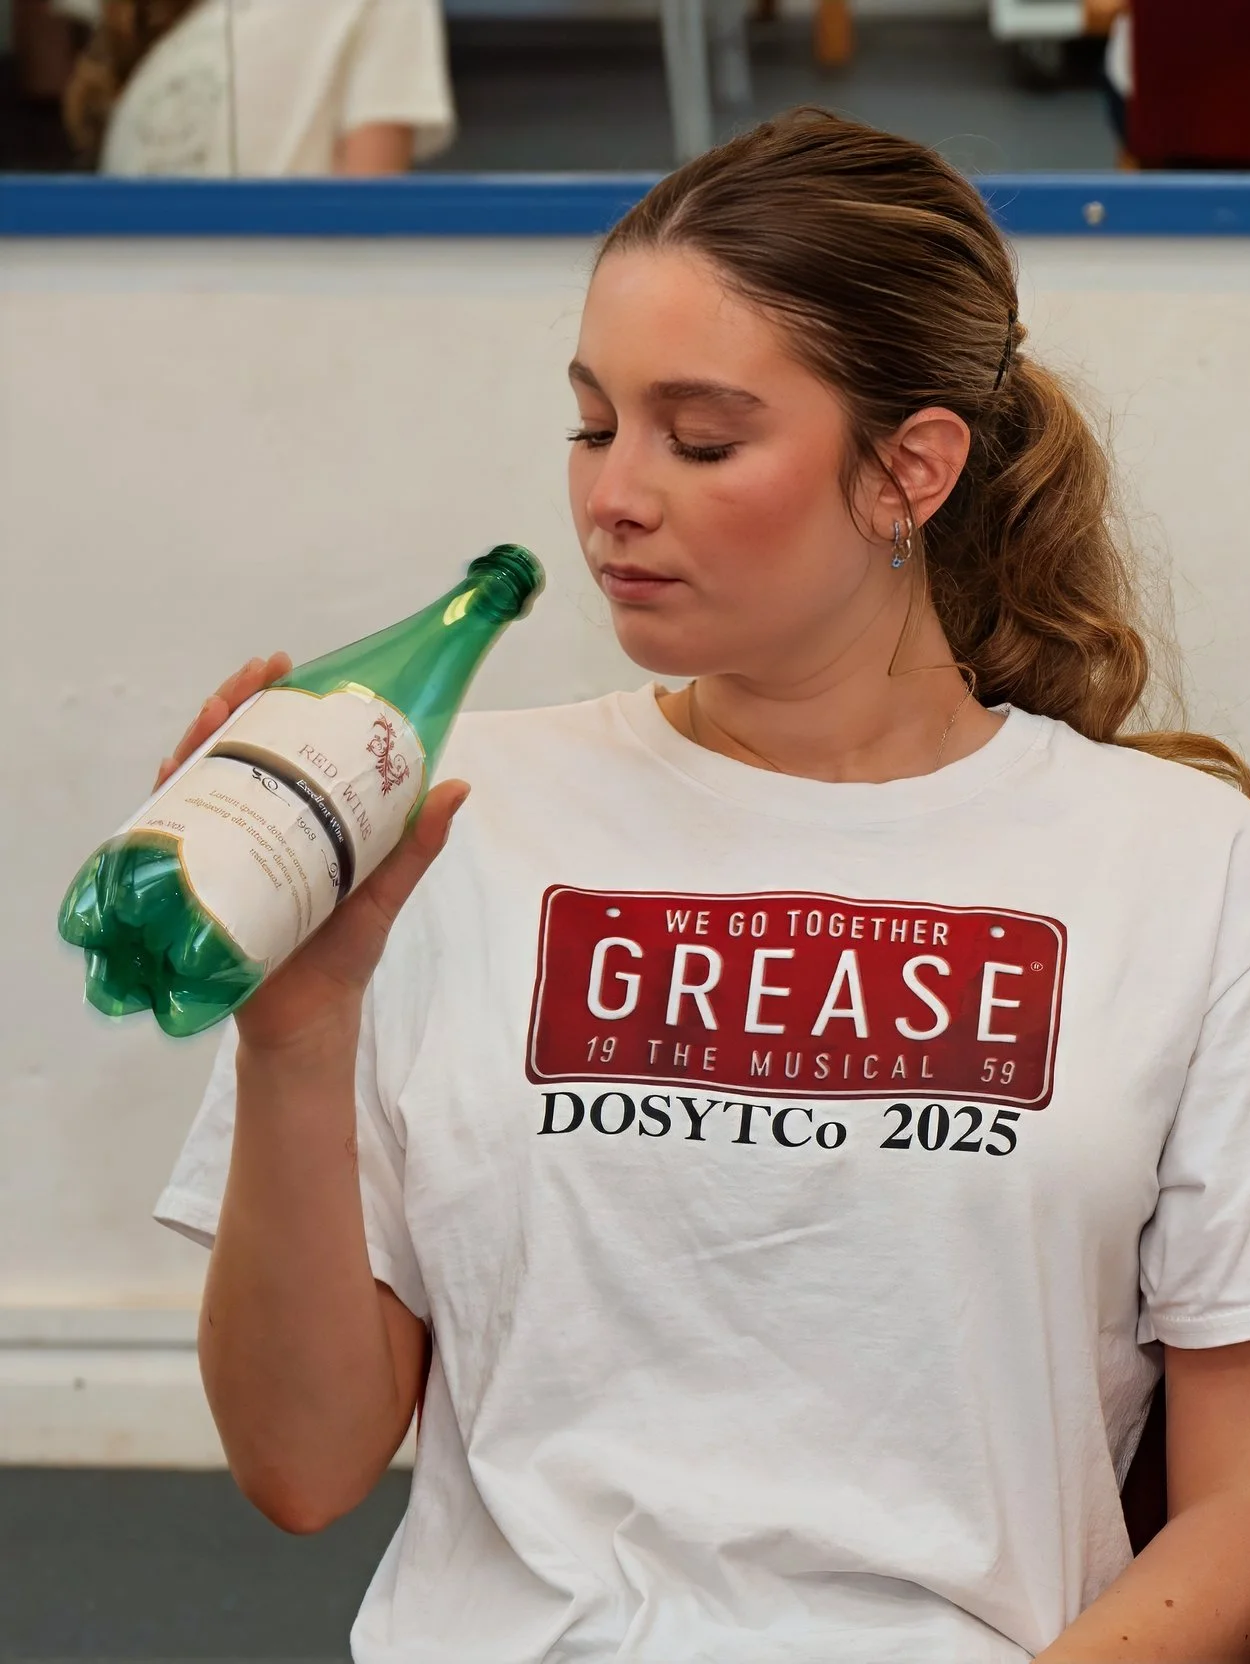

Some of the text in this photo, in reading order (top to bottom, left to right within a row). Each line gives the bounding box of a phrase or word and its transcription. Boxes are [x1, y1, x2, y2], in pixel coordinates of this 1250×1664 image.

[296, 780, 344, 843] Excellent Wine
[299, 744, 372, 841] RED WINE
[266, 824, 287, 846] dolor
[666, 909, 950, 946] WE GO TOGETHER
[587, 936, 1024, 1043] GREASE
[586, 1036, 1017, 1085] 19 THE MUSICAL 59
[537, 1091, 1021, 1157] DOSYTCo 2025
